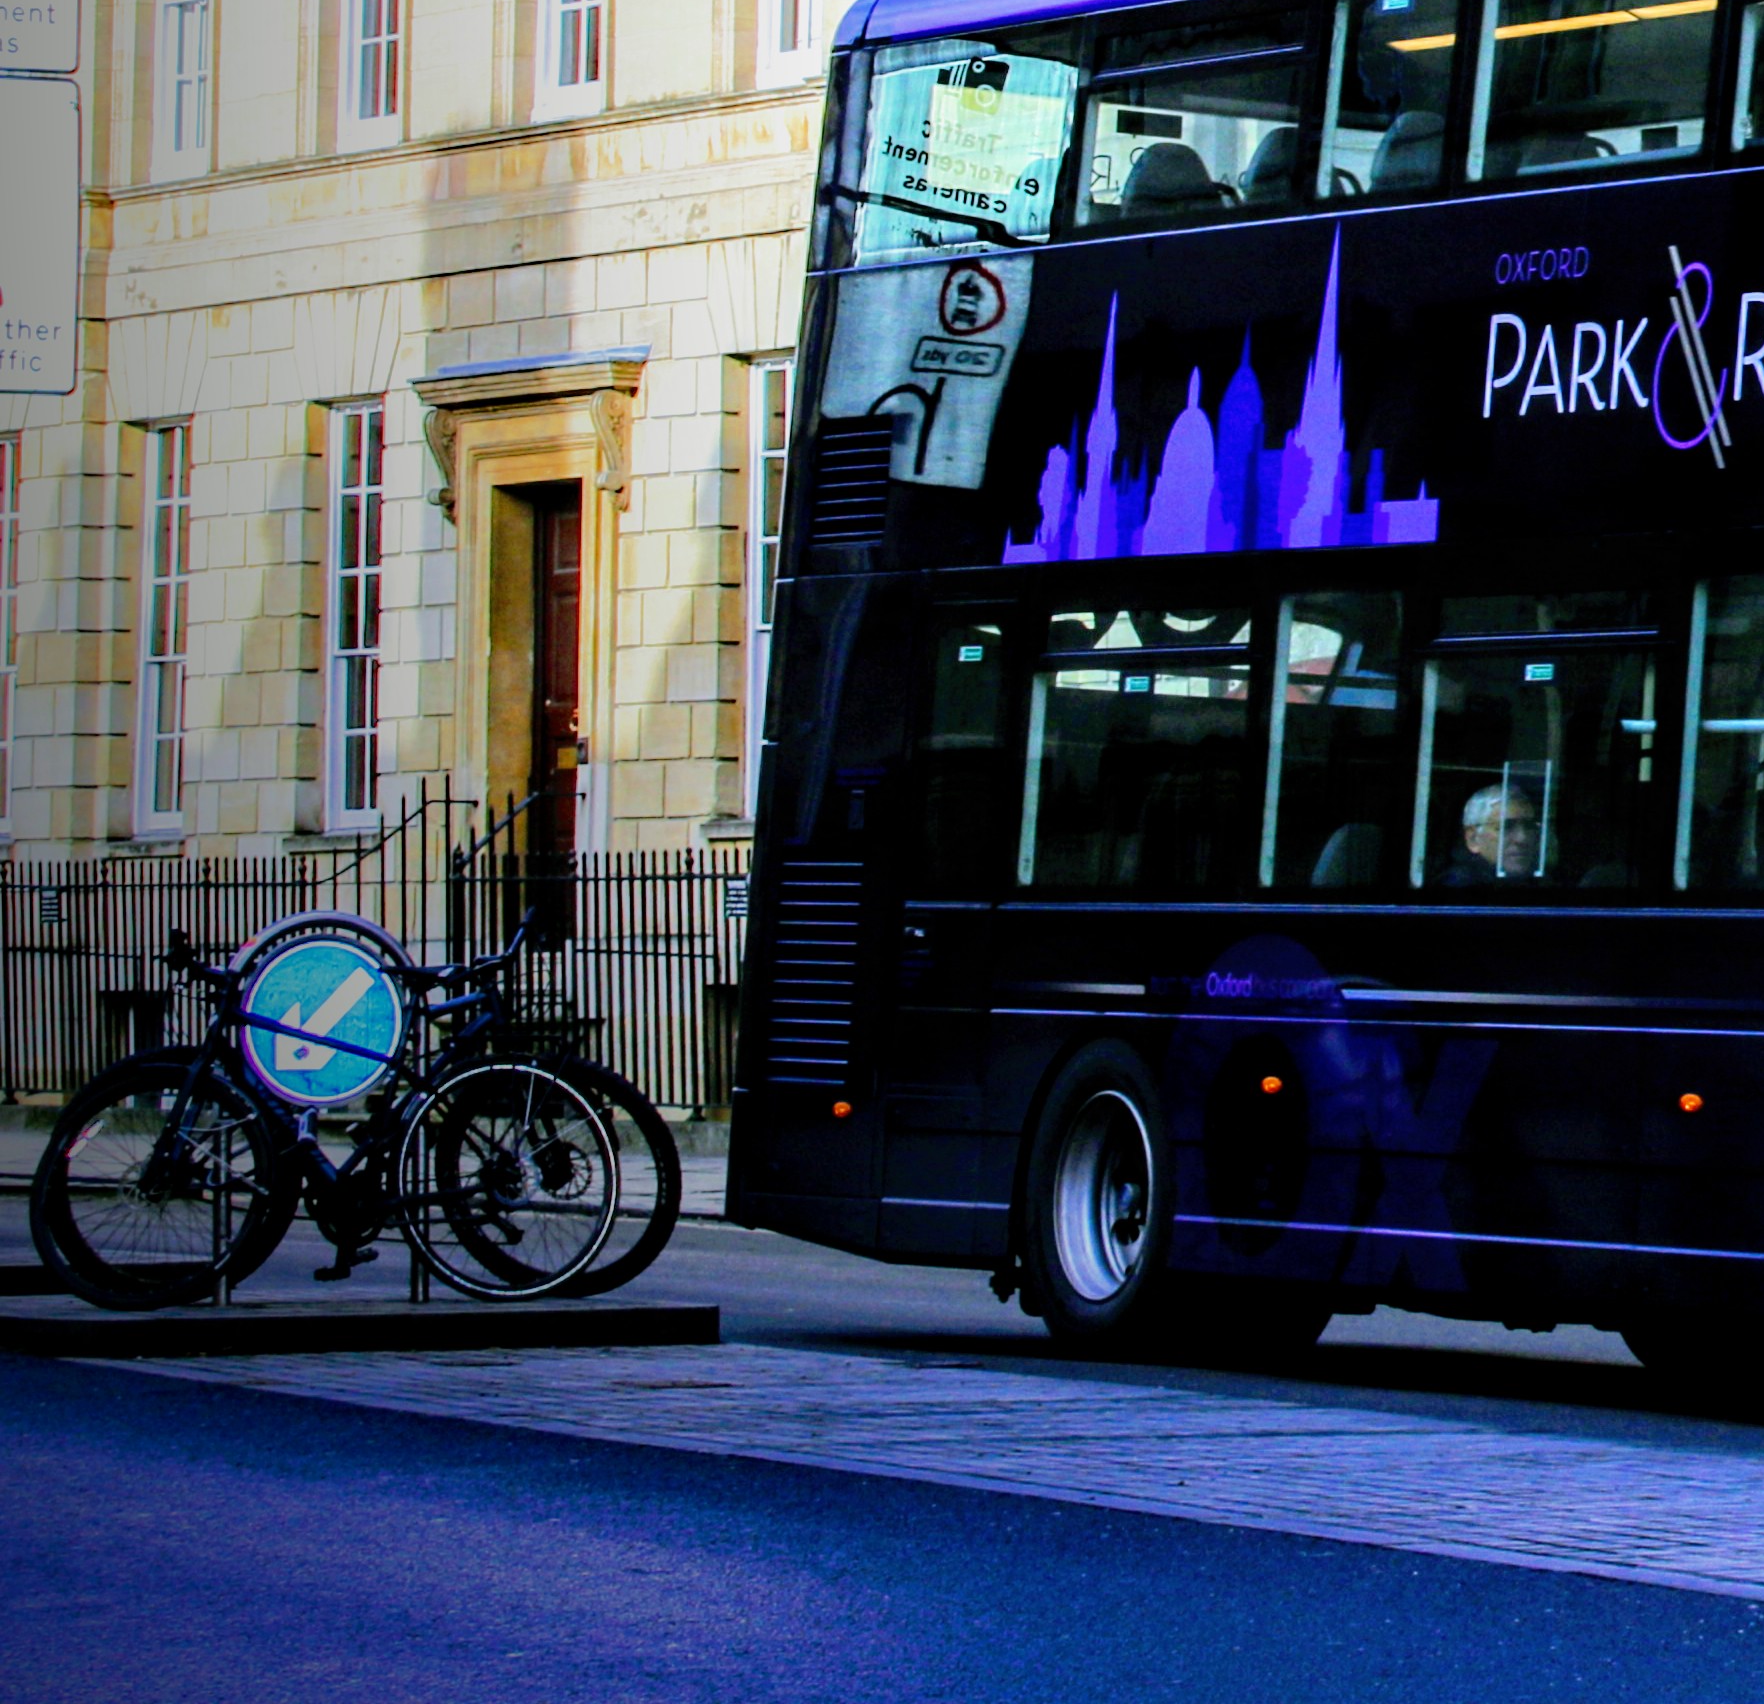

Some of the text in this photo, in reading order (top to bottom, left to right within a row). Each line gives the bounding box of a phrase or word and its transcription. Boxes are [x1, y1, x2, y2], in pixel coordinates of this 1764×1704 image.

[1495, 245, 1590, 285] OXFORD
[5, 319, 62, 341] ther
[1482, 312, 1649, 418] PARK
